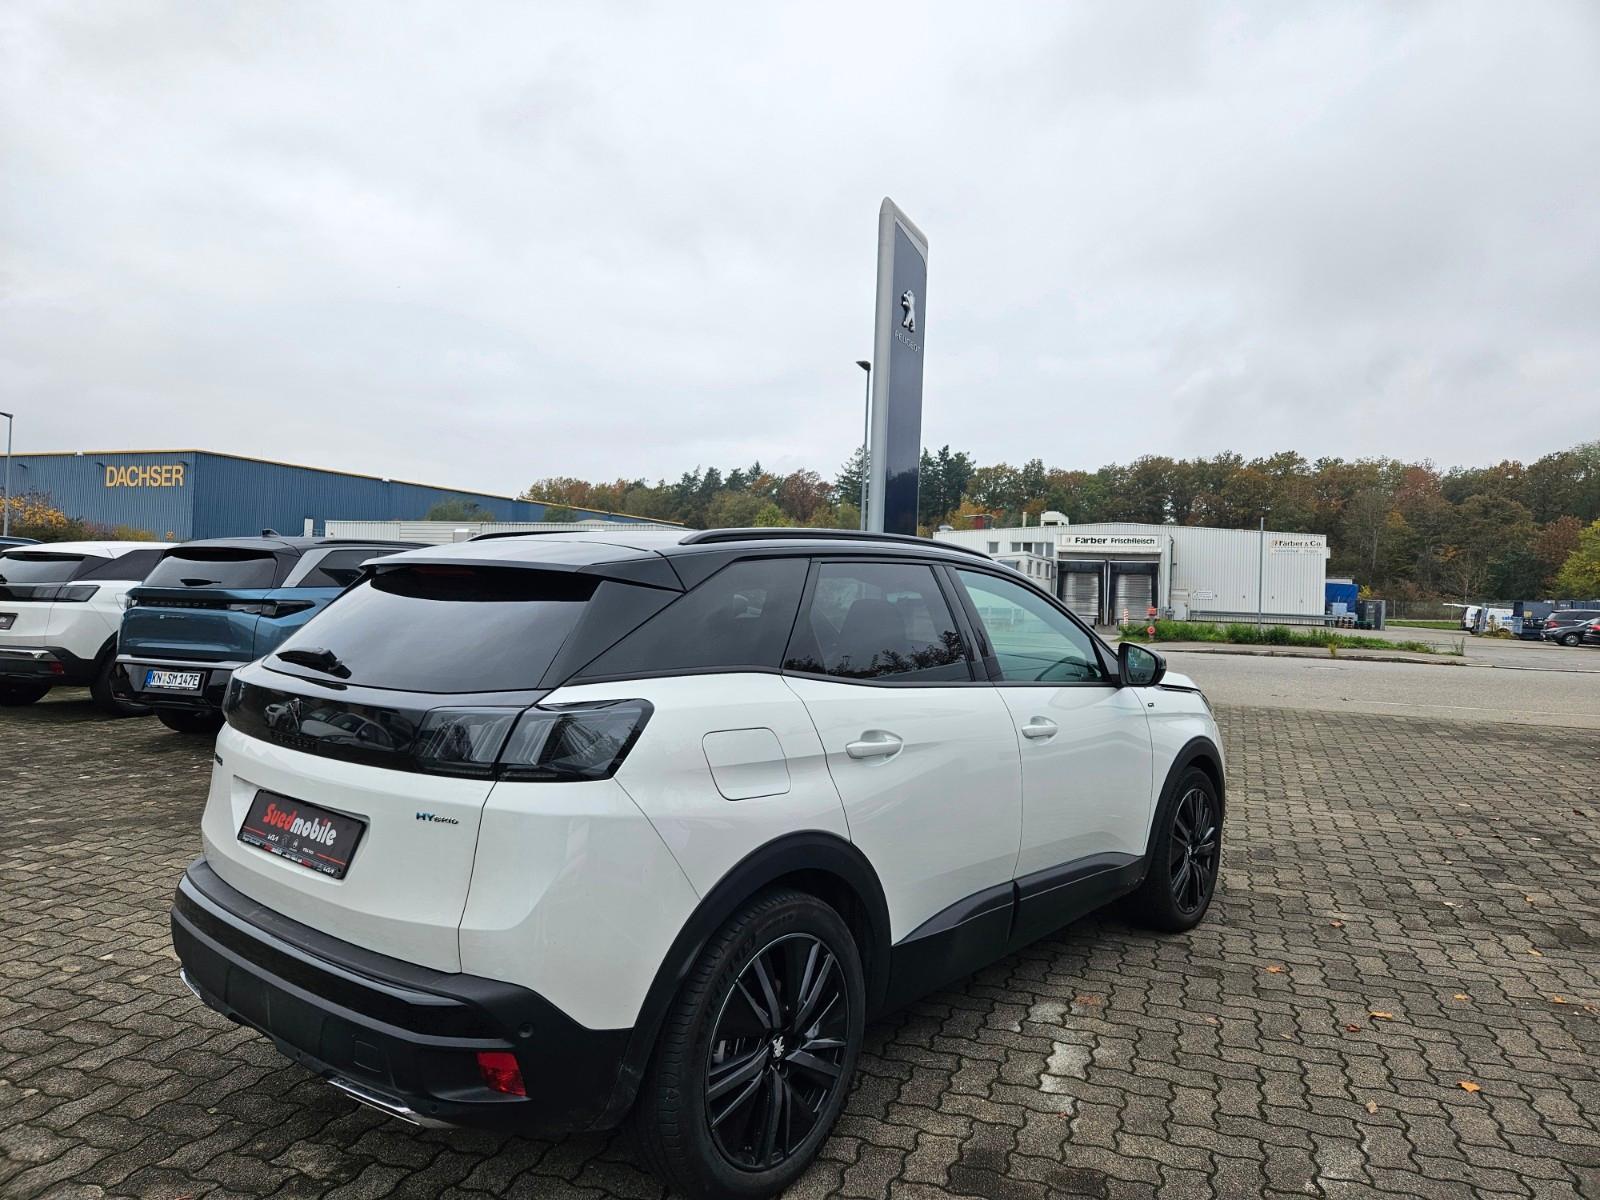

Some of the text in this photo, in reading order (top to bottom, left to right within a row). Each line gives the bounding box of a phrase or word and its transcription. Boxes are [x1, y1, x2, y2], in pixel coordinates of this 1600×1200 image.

[105, 465, 184, 487] DACHSER
[153, 672, 199, 687] KN SM 147E
[263, 803, 337, 846] Suedmobile
